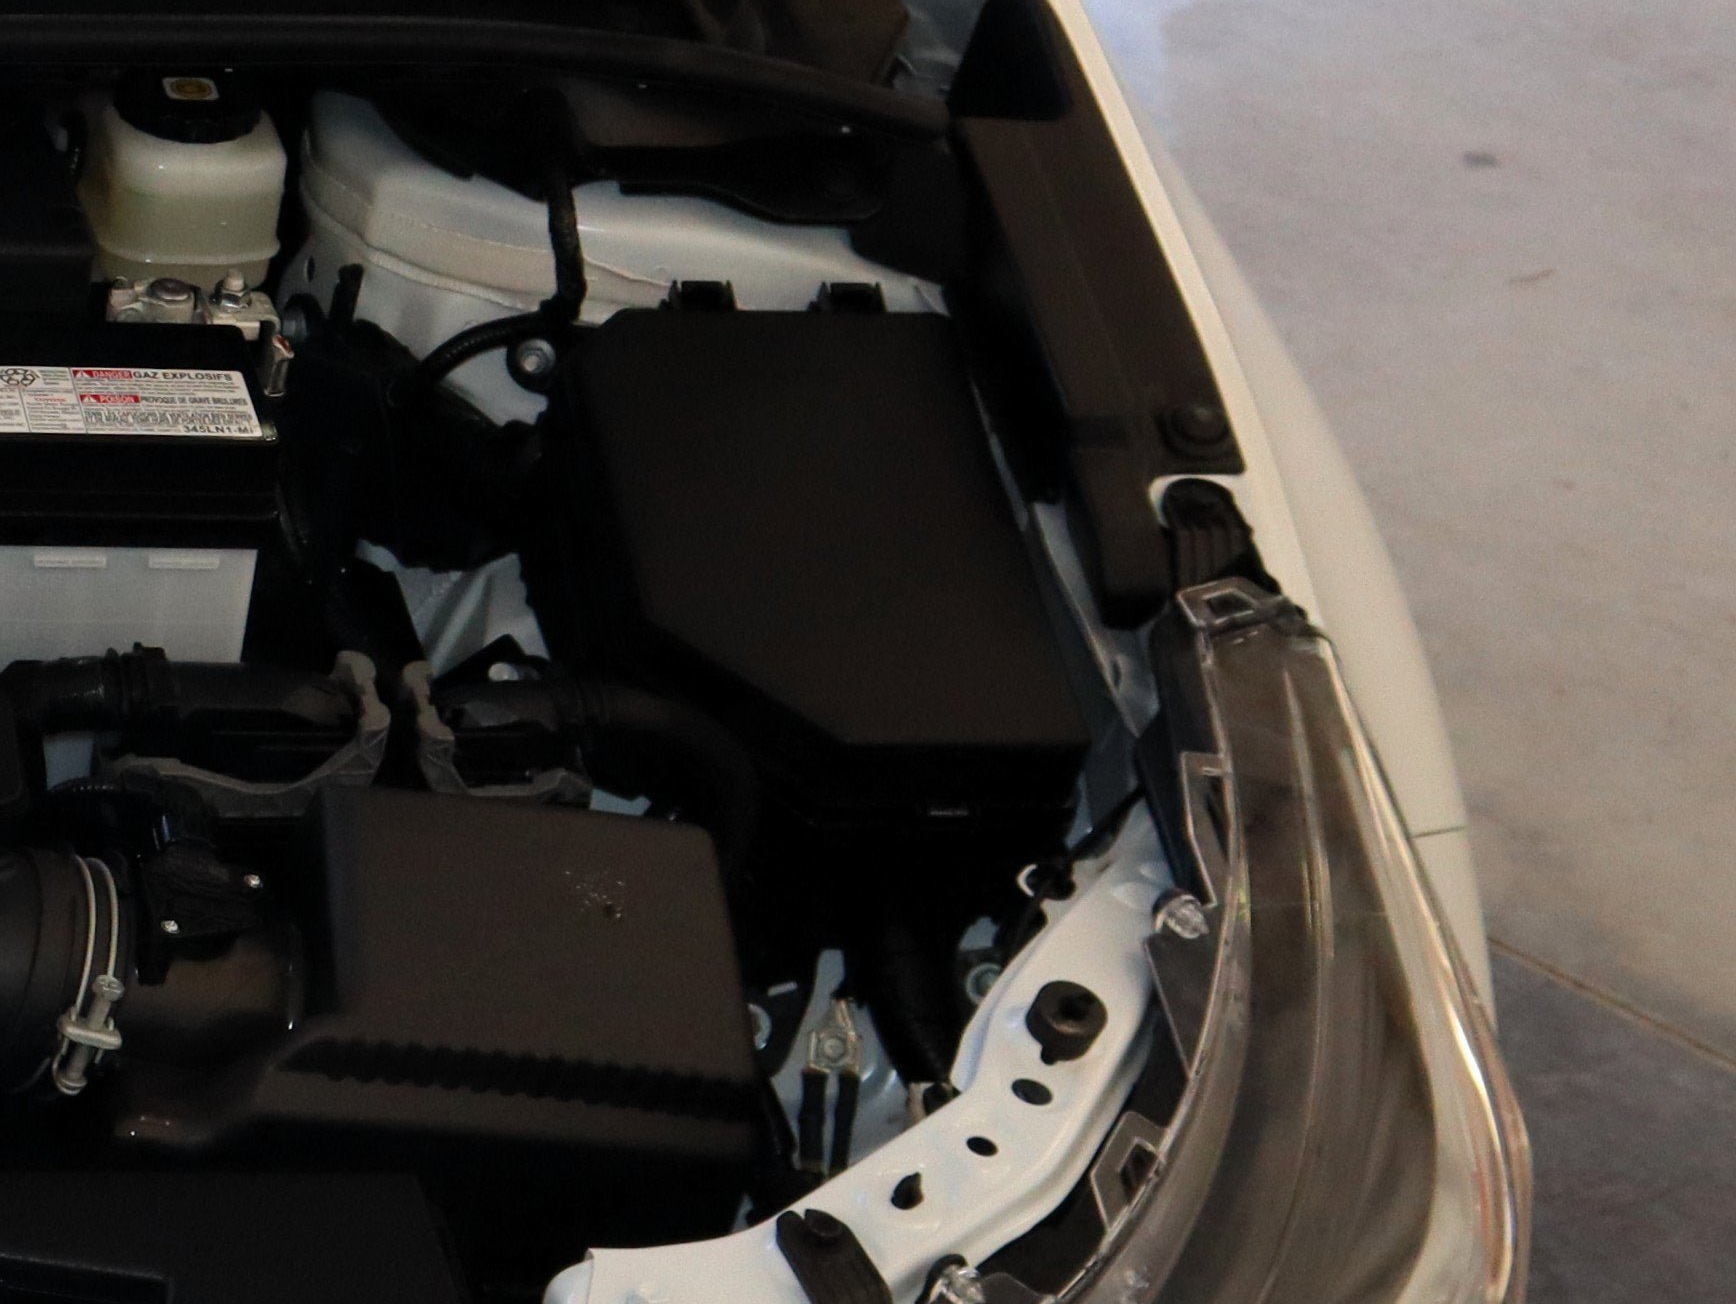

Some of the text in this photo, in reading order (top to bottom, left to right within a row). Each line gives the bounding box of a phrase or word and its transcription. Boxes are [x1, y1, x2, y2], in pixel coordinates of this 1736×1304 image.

[94, 371, 233, 381] DANGER GAZ EXPLOSIFS
[100, 395, 135, 403] POISON
